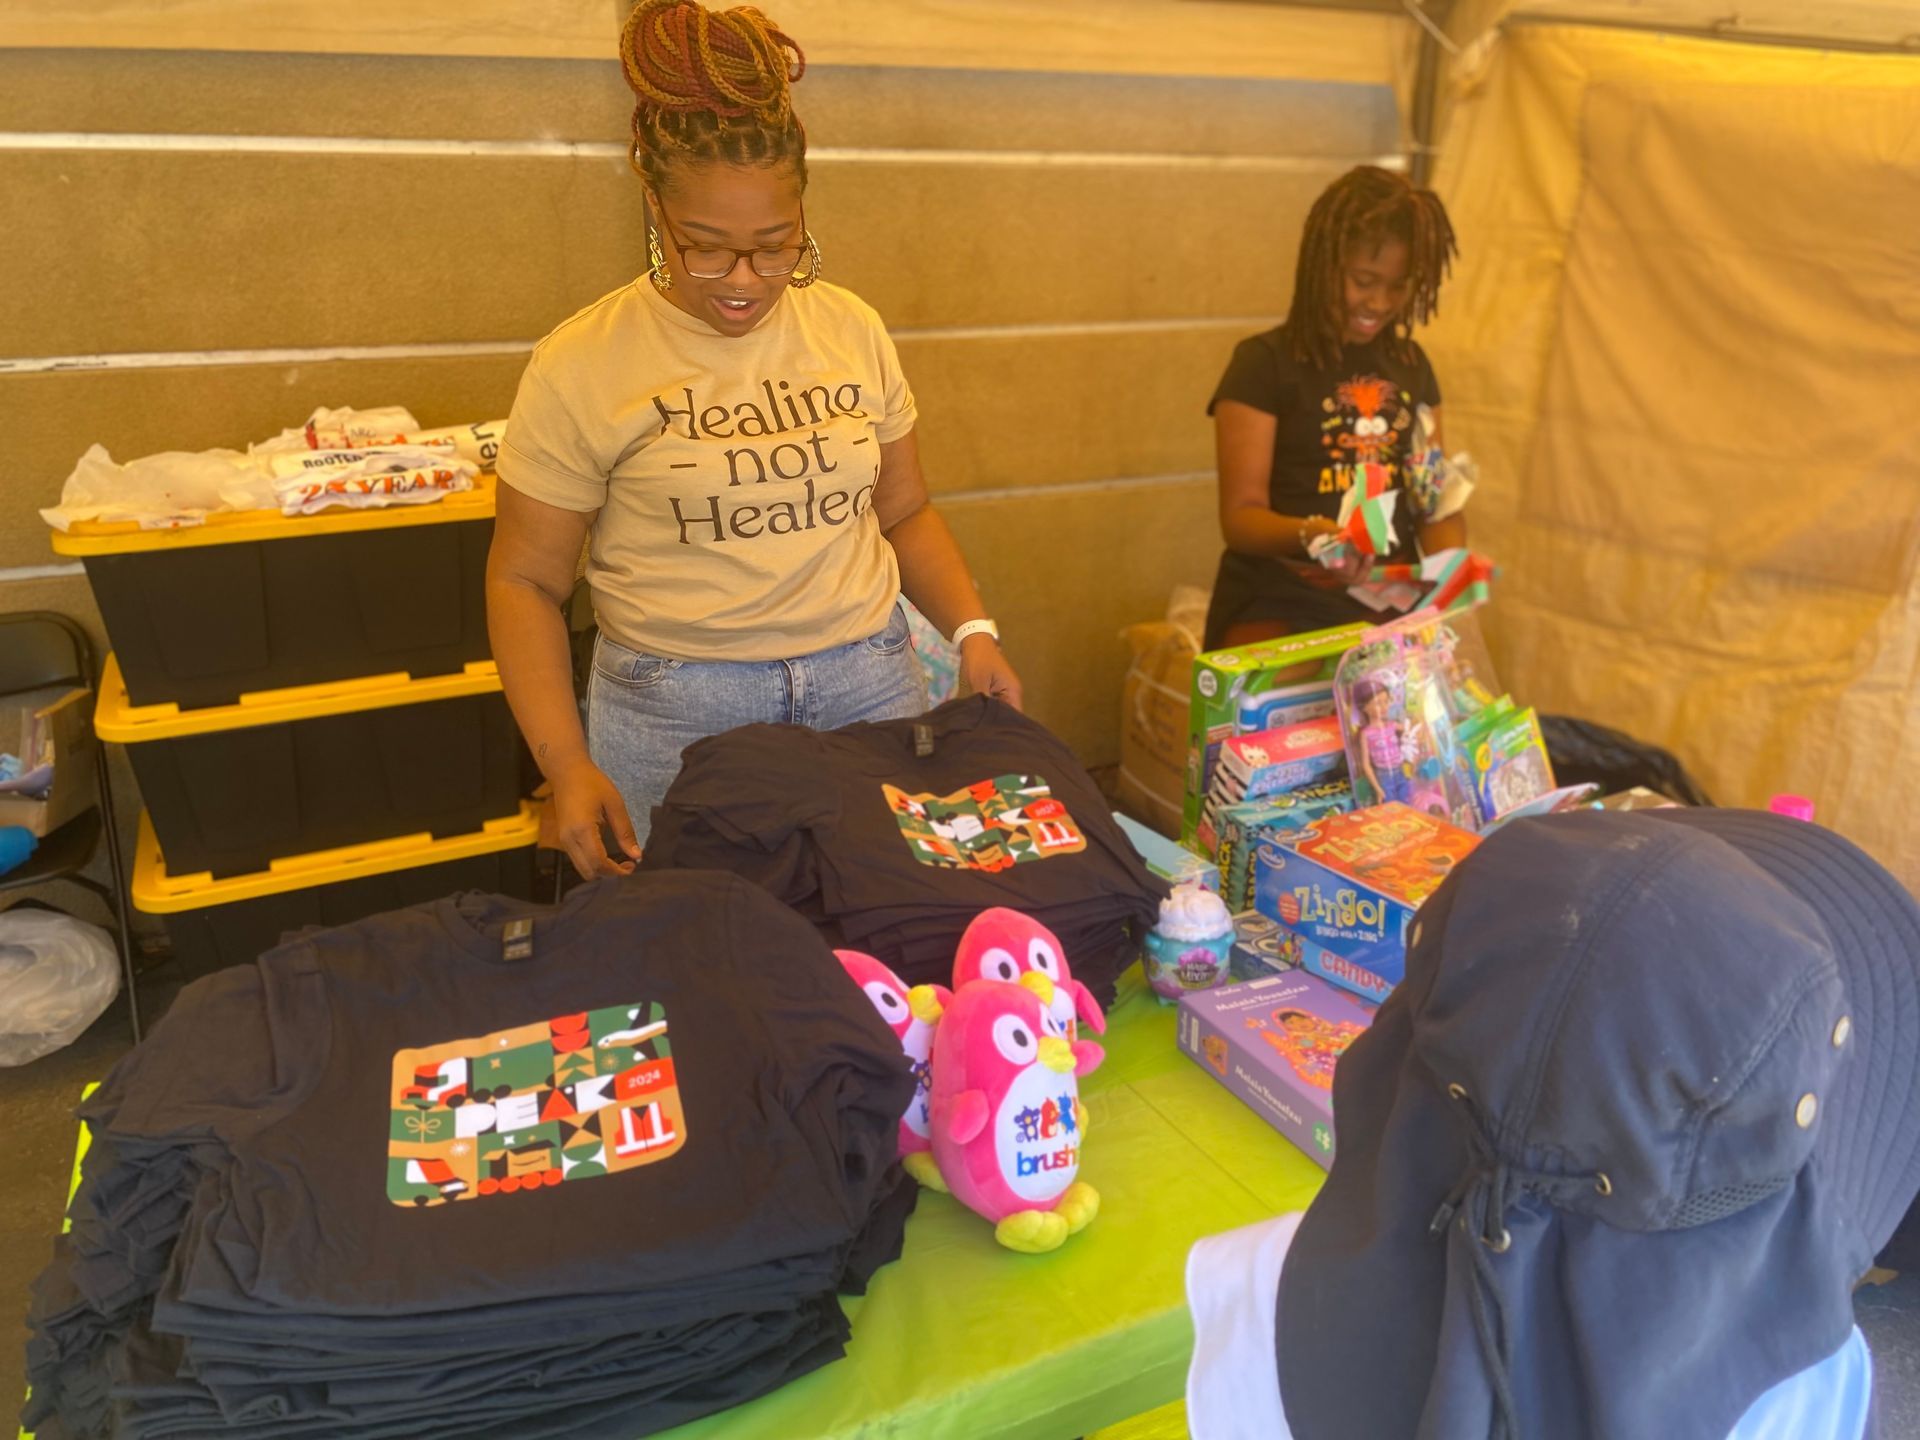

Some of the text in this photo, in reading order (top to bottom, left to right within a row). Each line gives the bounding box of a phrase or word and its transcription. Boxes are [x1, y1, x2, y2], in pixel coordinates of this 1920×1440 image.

[652, 379, 868, 440] Healing
[723, 430, 838, 487] not
[1294, 883, 1387, 938] Zingo!
[1320, 949, 1387, 993] CANDY
[627, 1068, 662, 1090] 2024
